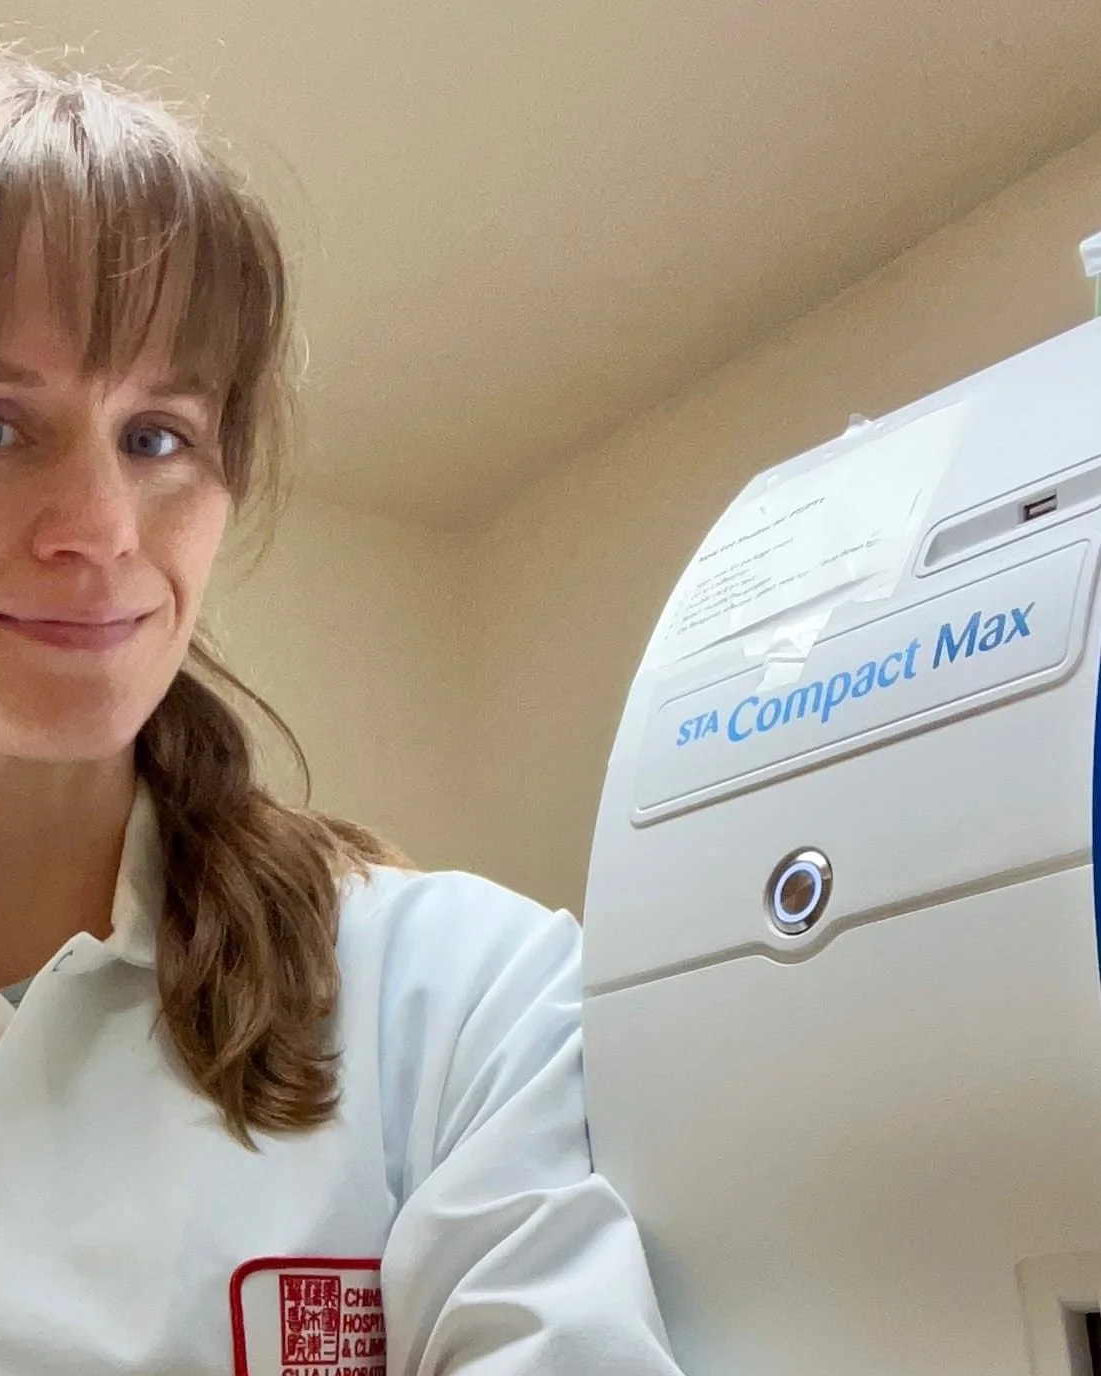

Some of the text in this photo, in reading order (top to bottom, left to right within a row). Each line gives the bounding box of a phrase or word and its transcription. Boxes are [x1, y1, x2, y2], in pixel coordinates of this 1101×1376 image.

[676, 601, 1036, 746] STA Compact Max
[342, 1338, 352, 1358] &
